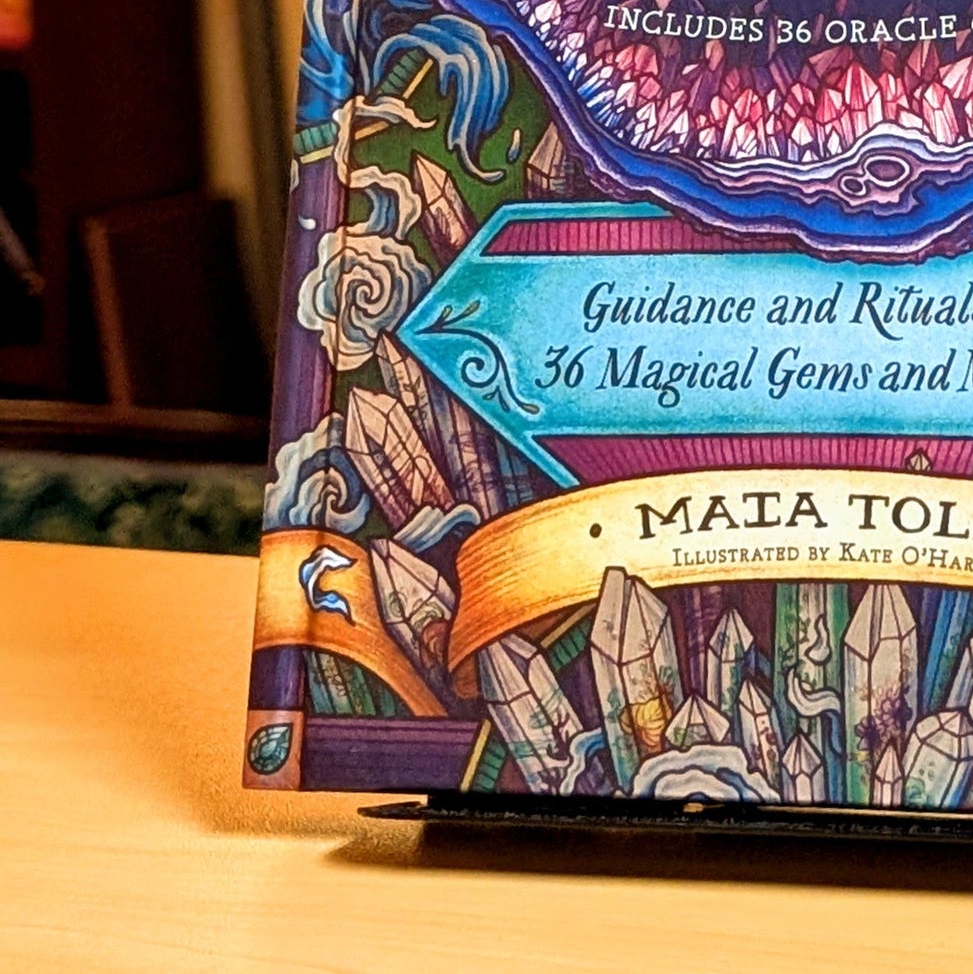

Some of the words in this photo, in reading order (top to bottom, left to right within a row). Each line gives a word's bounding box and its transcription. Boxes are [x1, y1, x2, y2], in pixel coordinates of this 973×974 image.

[604, 4, 764, 43] INCLUDES
[775, 21, 813, 44] 36
[826, 15, 958, 44] ORACLE
[583, 281, 756, 332] Guidance
[767, 282, 843, 325] and
[534, 345, 593, 389] 36
[594, 345, 758, 409] Magical
[766, 347, 872, 400] Gems
[877, 348, 956, 393] and
[635, 492, 828, 539] MAIA
[671, 546, 801, 568] ILLUSTRATED
[808, 548, 829, 563] BY
[838, 543, 893, 565] KATE
